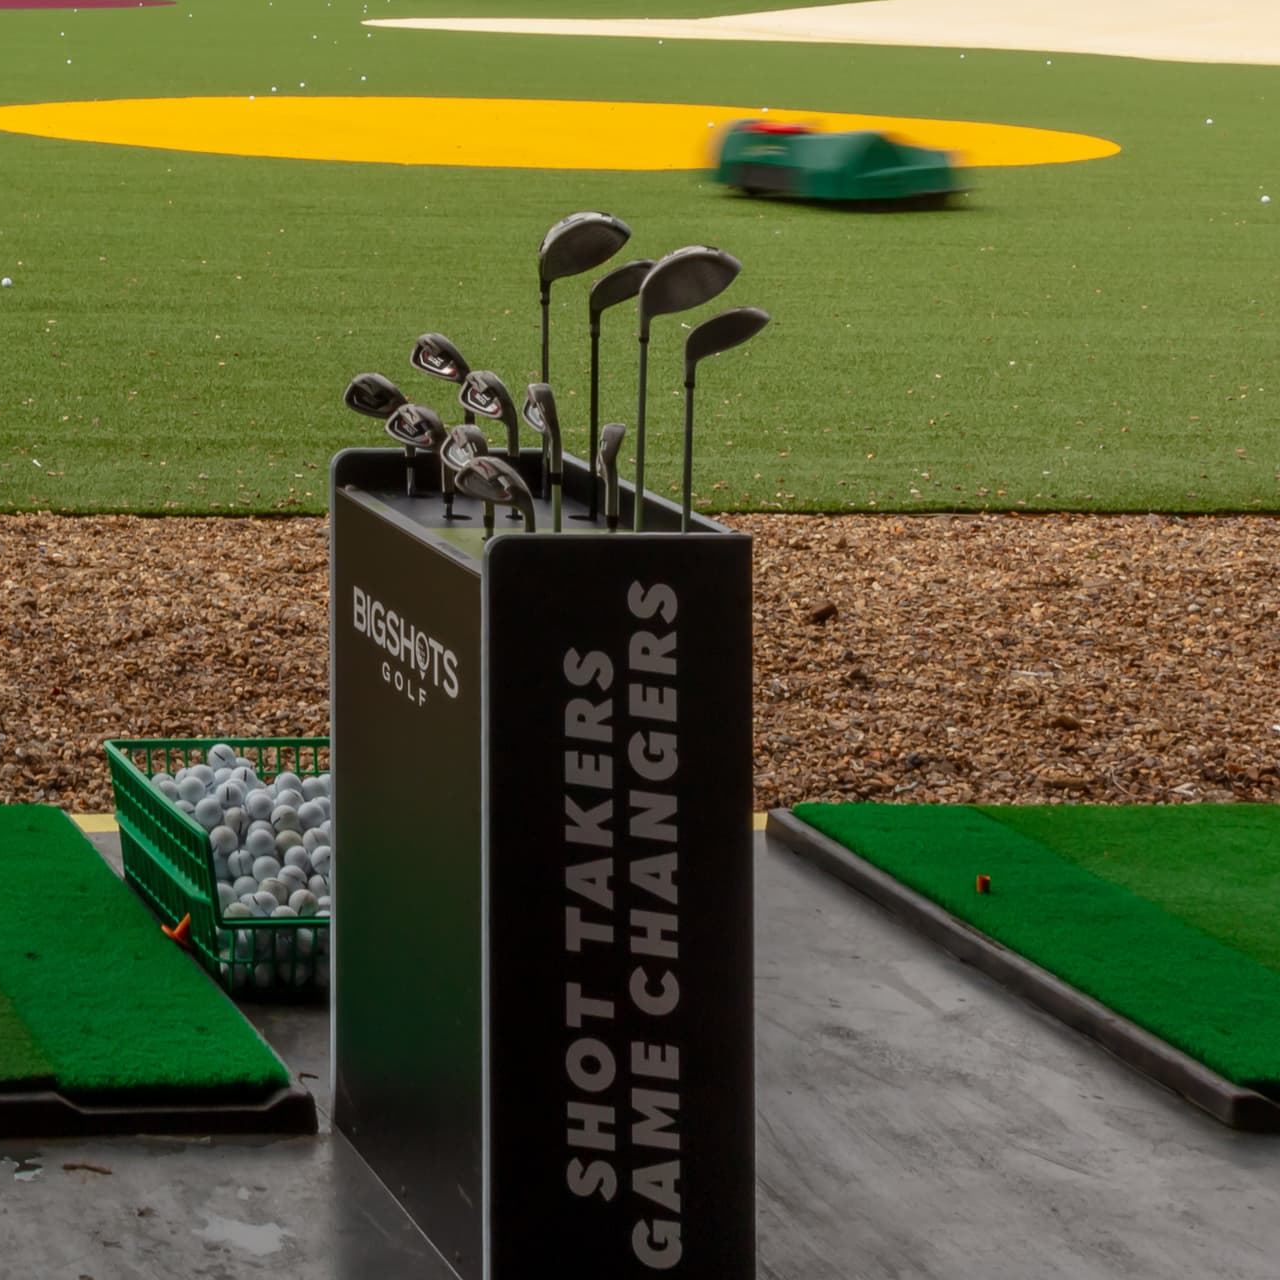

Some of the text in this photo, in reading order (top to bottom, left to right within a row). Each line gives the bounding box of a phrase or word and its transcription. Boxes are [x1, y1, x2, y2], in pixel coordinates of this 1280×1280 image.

[353, 585, 459, 699] BIGSHOTS
[382, 661, 427, 707] GOLF
[563, 647, 618, 1202] SHOT TAKERS
[627, 580, 683, 1271] GAME CHANGERS
